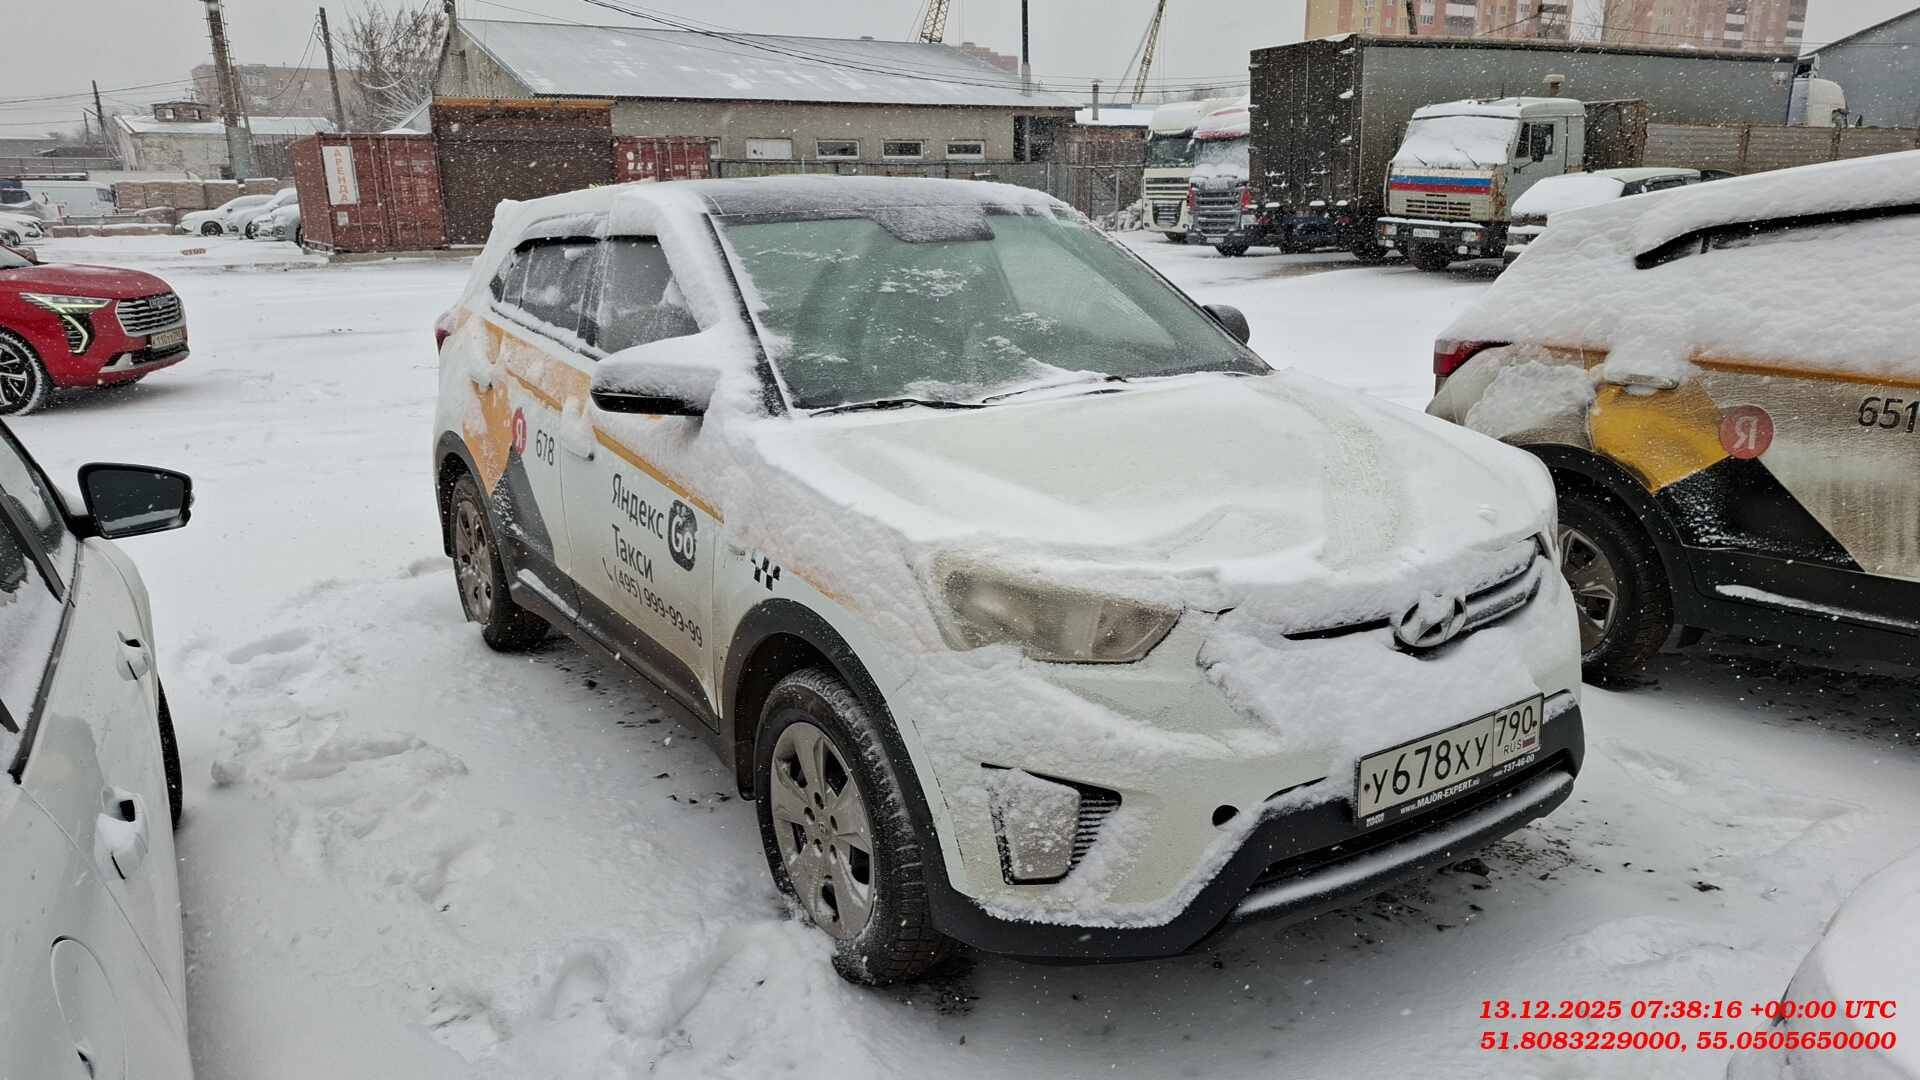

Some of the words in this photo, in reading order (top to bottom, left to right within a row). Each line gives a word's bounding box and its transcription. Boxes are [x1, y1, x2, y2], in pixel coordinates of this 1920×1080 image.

[333, 148, 350, 202] АРЕНДА
[515, 417, 524, 449] Я
[1733, 415, 1759, 450] Я
[1858, 396, 1920, 434] 651
[536, 429, 555, 466] 678
[611, 472, 665, 540] Яндекс
[611, 523, 654, 584] Такси
[671, 515, 694, 560] Go
[614, 565, 643, 606] (495)
[1371, 732, 1489, 804] У678ХУ
[1495, 705, 1533, 747] 790
[1503, 738, 1522, 756] RUS
